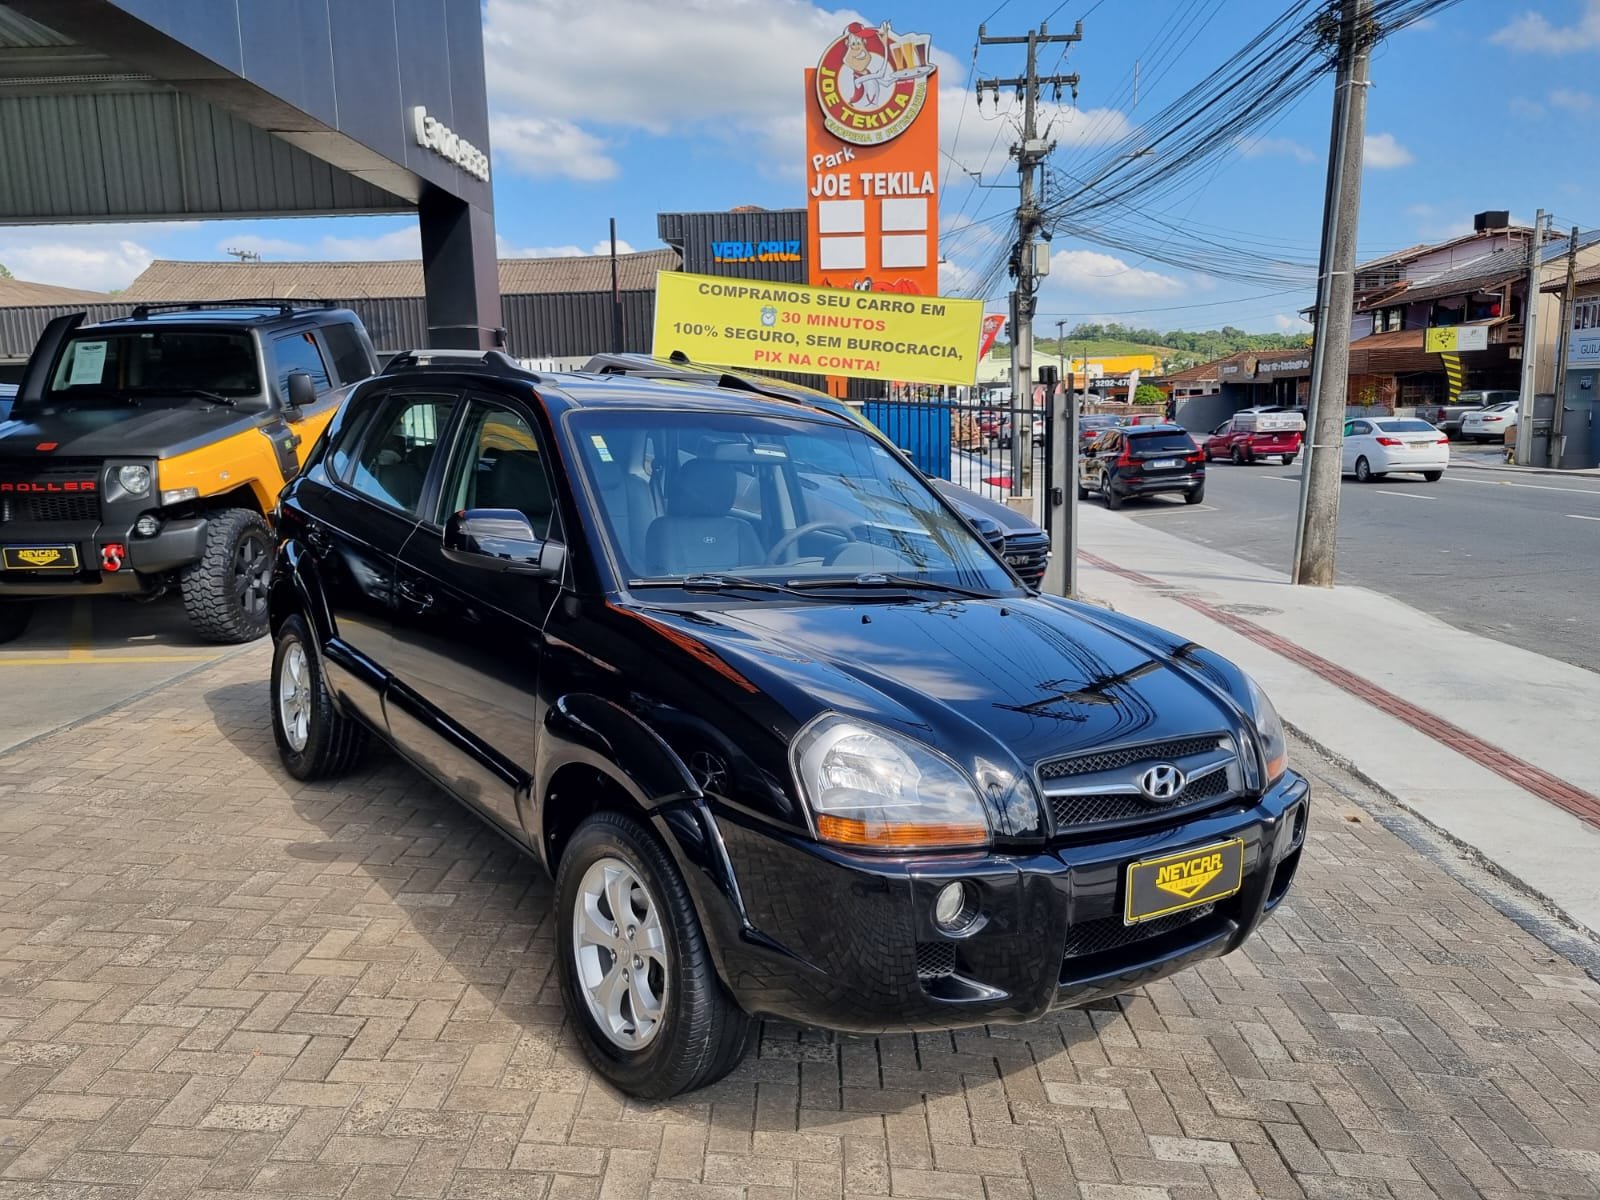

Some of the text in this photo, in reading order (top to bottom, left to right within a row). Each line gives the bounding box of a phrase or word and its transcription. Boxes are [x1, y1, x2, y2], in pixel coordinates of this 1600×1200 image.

[821, 66, 840, 108] JOE
[840, 94, 910, 128] TEKILA
[812, 146, 855, 172] Park
[811, 171, 935, 197] JOE TEKILA
[711, 239, 801, 262] VERA CRUZ
[698, 283, 946, 317] COMPRAMOS SEU CARRO EM
[781, 311, 886, 332] 30 MINUTOS
[673, 322, 963, 360] 100% SEGURO, SEM BUROCRACIA,
[754, 350, 880, 372] PIX NA CONTA!
[0, 481, 96, 492] ROLLER
[18, 549, 60, 559] NEYCAR
[1156, 853, 1223, 885] NEYCAR
